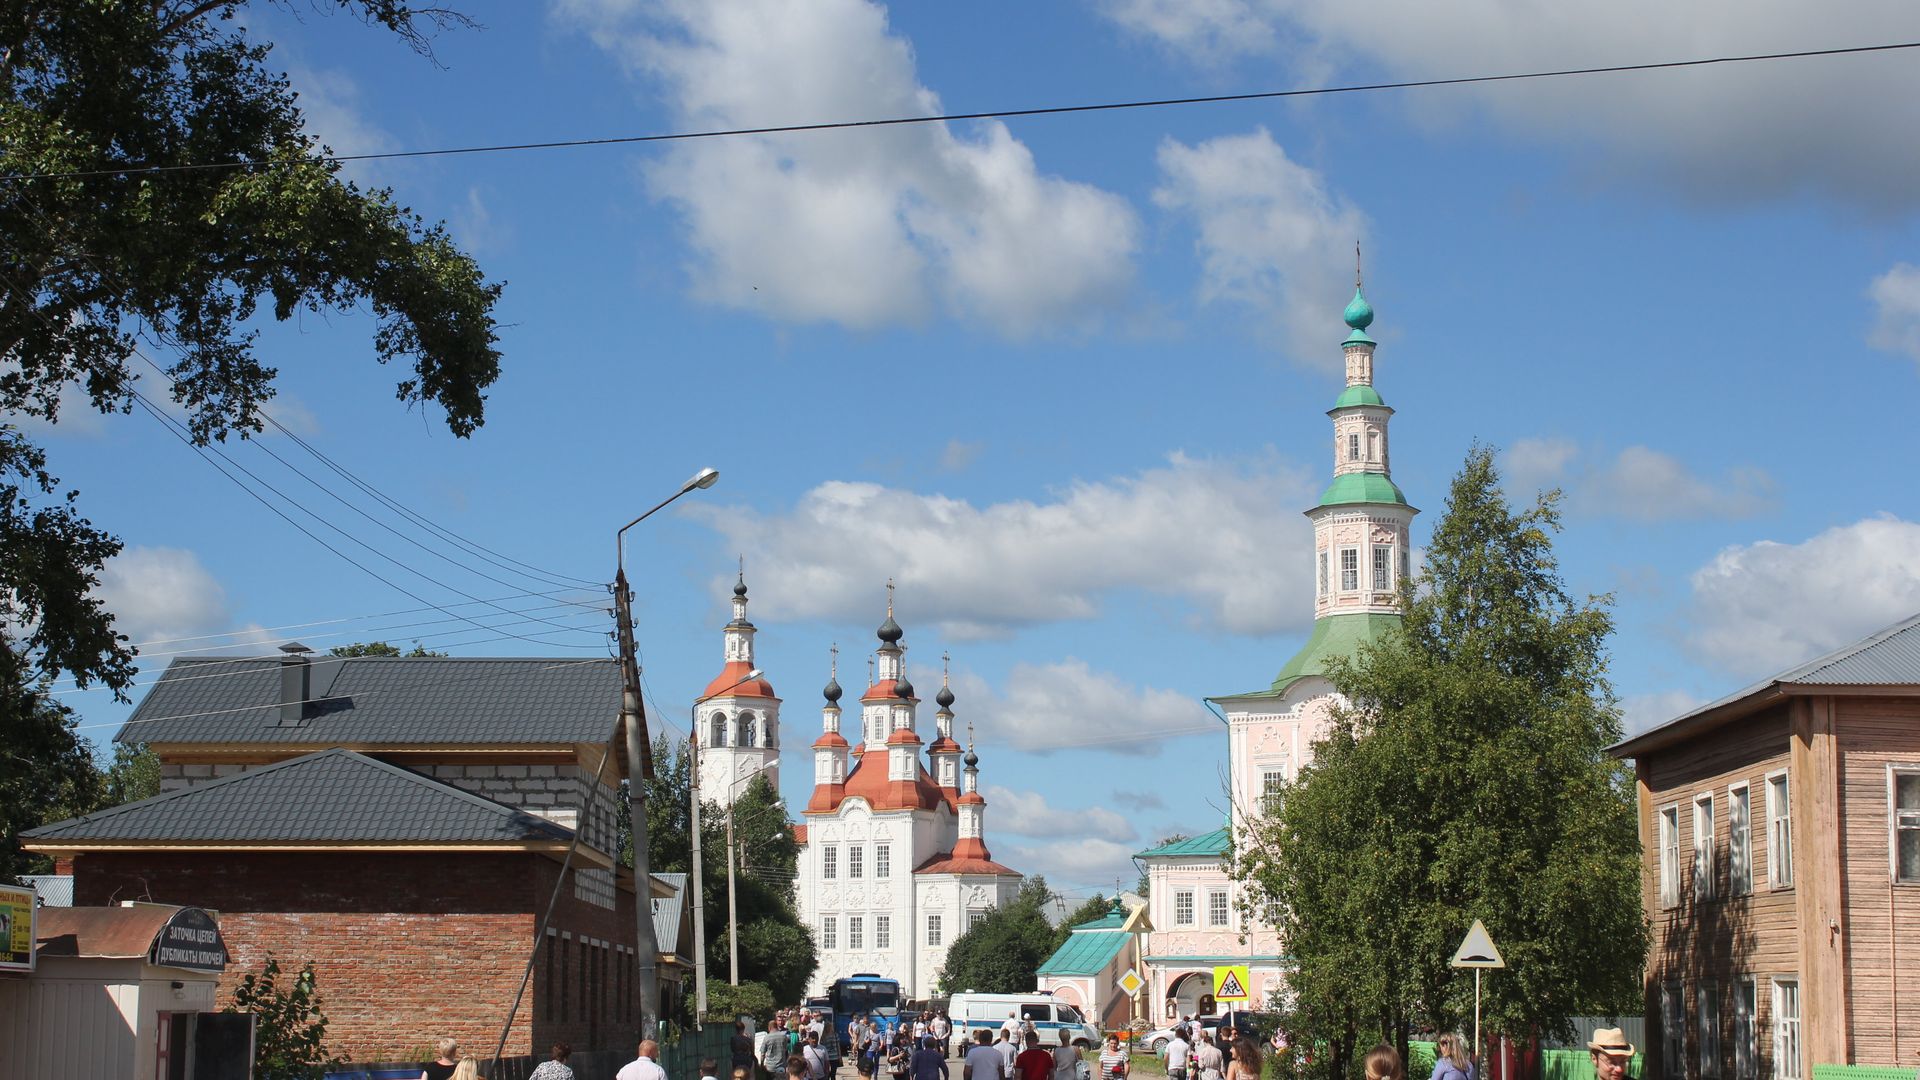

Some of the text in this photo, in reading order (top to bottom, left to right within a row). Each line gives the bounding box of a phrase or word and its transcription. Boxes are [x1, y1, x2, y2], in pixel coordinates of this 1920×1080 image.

[170, 927, 216, 944] ЗАТОЧКА ЦЕПЕЙ
[161, 947, 223, 965] ДУБЛИКАТЫ КЛЮЧЕЙ
